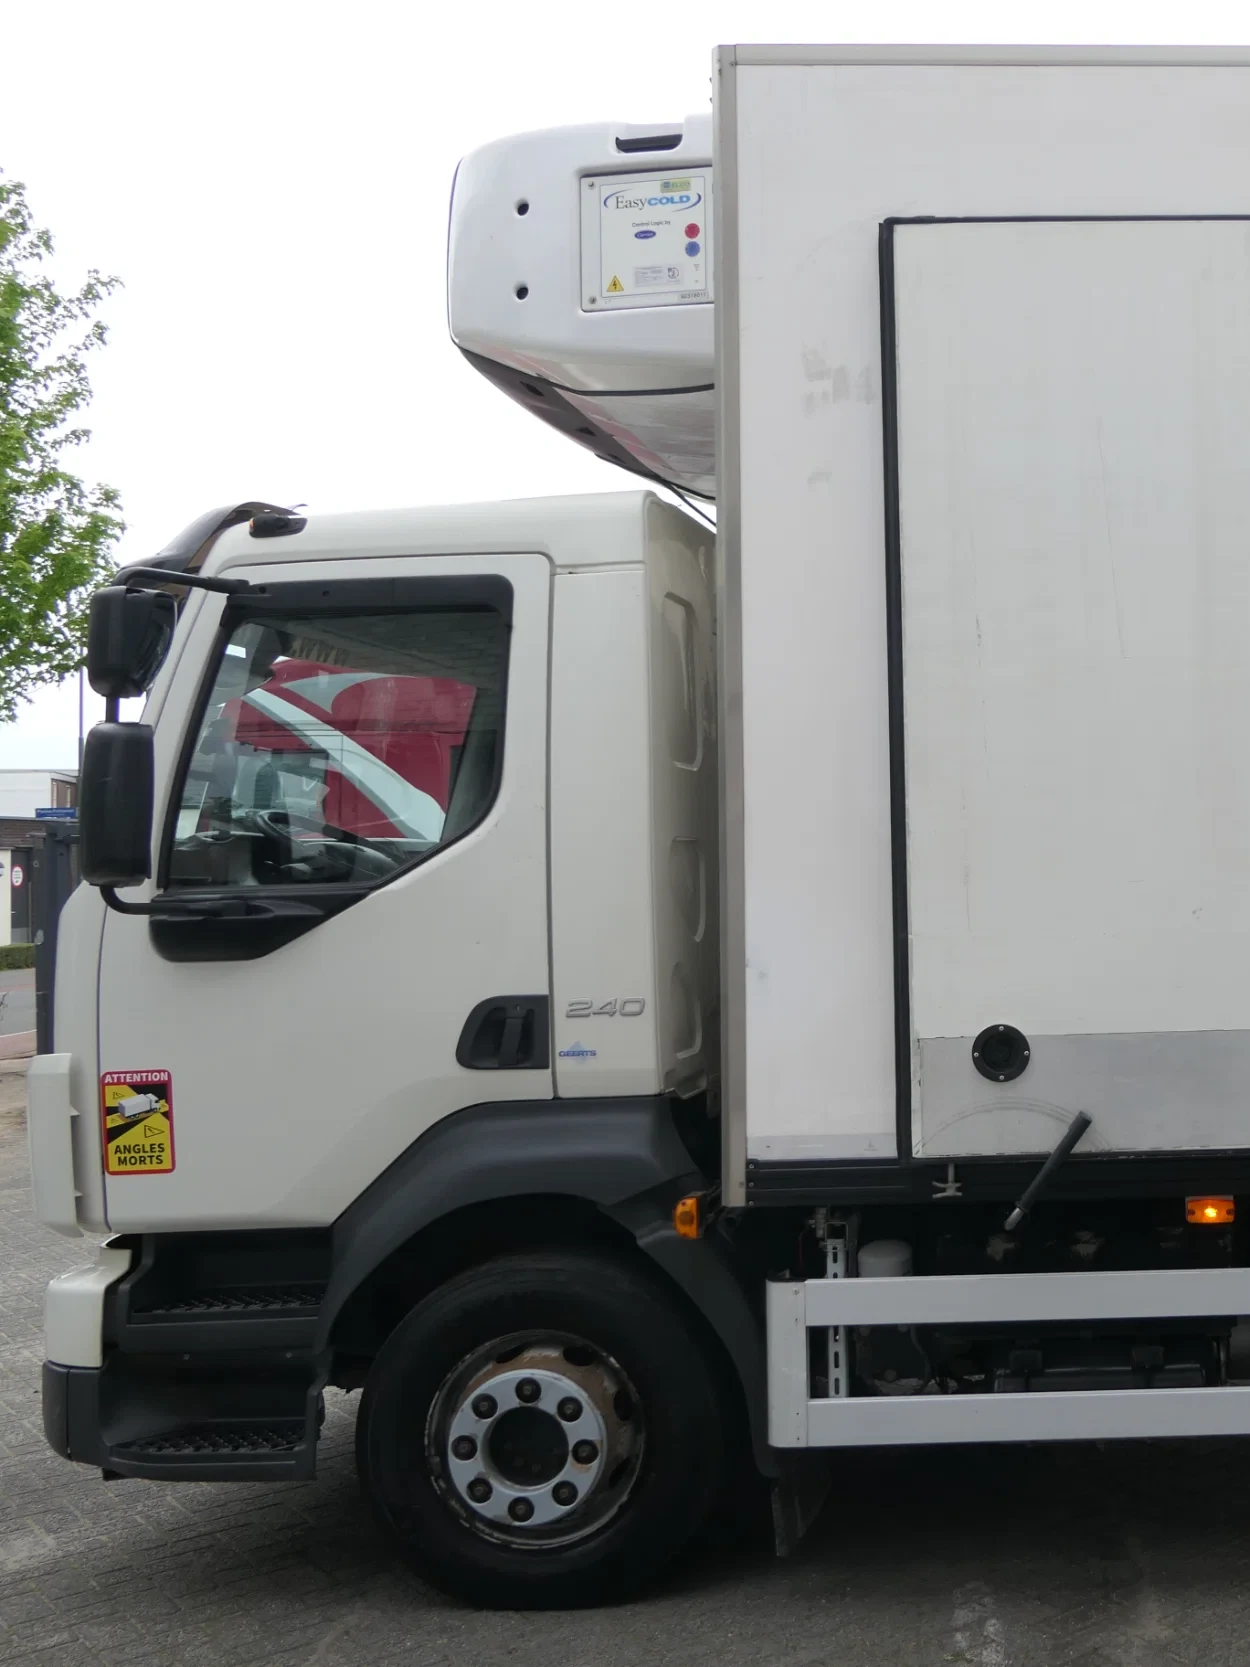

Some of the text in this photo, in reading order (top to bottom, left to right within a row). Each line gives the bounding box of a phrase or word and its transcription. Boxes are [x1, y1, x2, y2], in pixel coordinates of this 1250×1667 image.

[615, 195, 691, 211] EasyCOLD
[565, 997, 646, 1018] 240
[104, 1072, 168, 1083] ATTENTION
[114, 1143, 165, 1155] ANGLES
[117, 1155, 164, 1166] MORTS
